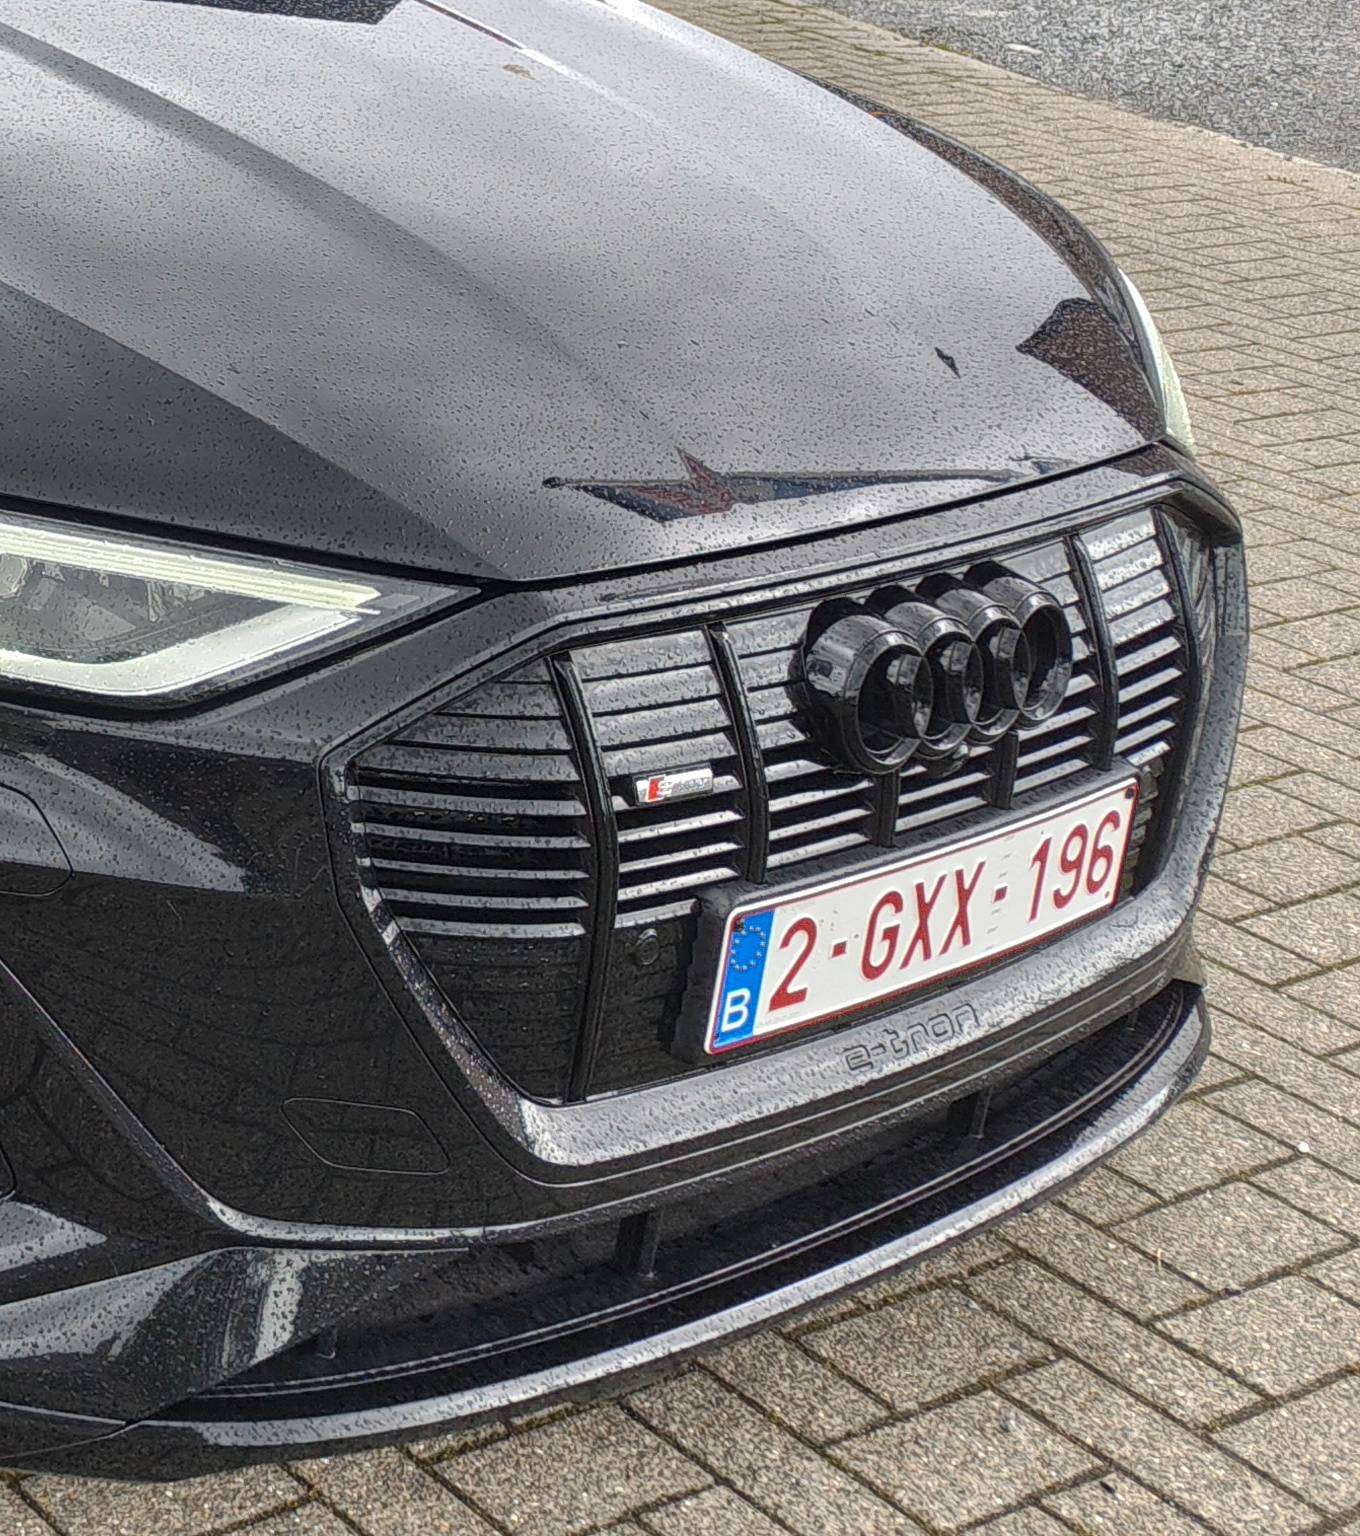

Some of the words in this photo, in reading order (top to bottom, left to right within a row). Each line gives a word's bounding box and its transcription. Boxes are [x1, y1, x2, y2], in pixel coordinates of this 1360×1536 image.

[768, 809, 1120, 1012] 2-GXX-196
[722, 988, 750, 1033] B
[845, 1002, 981, 1072] e-tron
